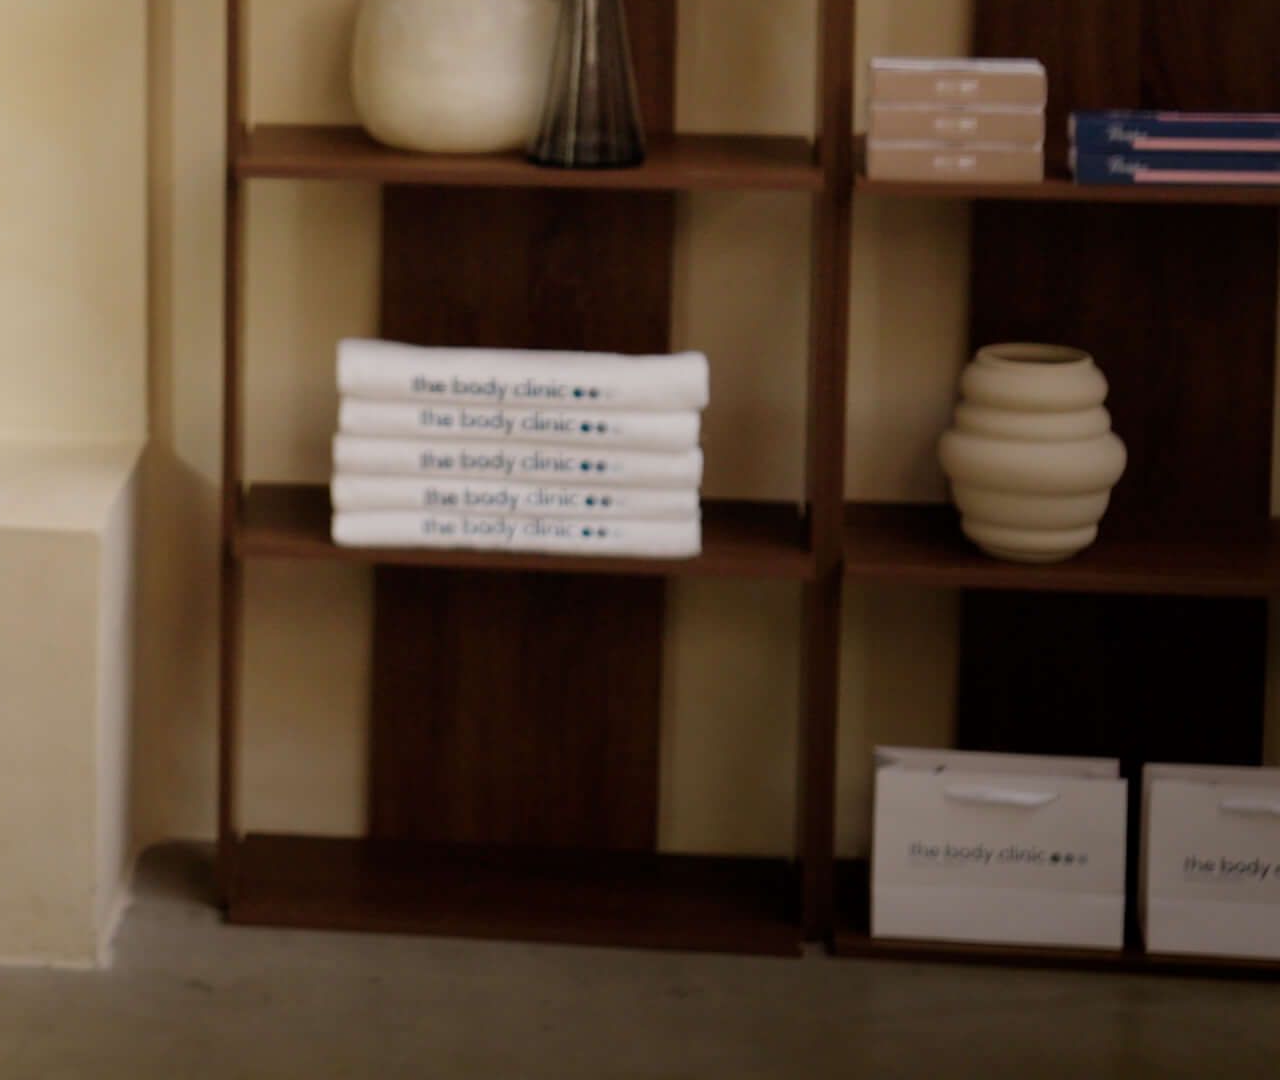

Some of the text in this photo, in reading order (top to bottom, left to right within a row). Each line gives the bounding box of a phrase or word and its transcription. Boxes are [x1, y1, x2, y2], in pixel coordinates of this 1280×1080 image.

[411, 374, 566, 402] the body clinic
[418, 408, 572, 435] the body clinic
[420, 448, 574, 476] the body clinic
[424, 486, 579, 511] the body clinic
[421, 517, 573, 544] the body clinic
[909, 840, 1044, 865] the body clinic
[1183, 854, 1216, 874] the
[1220, 855, 1271, 882] body
